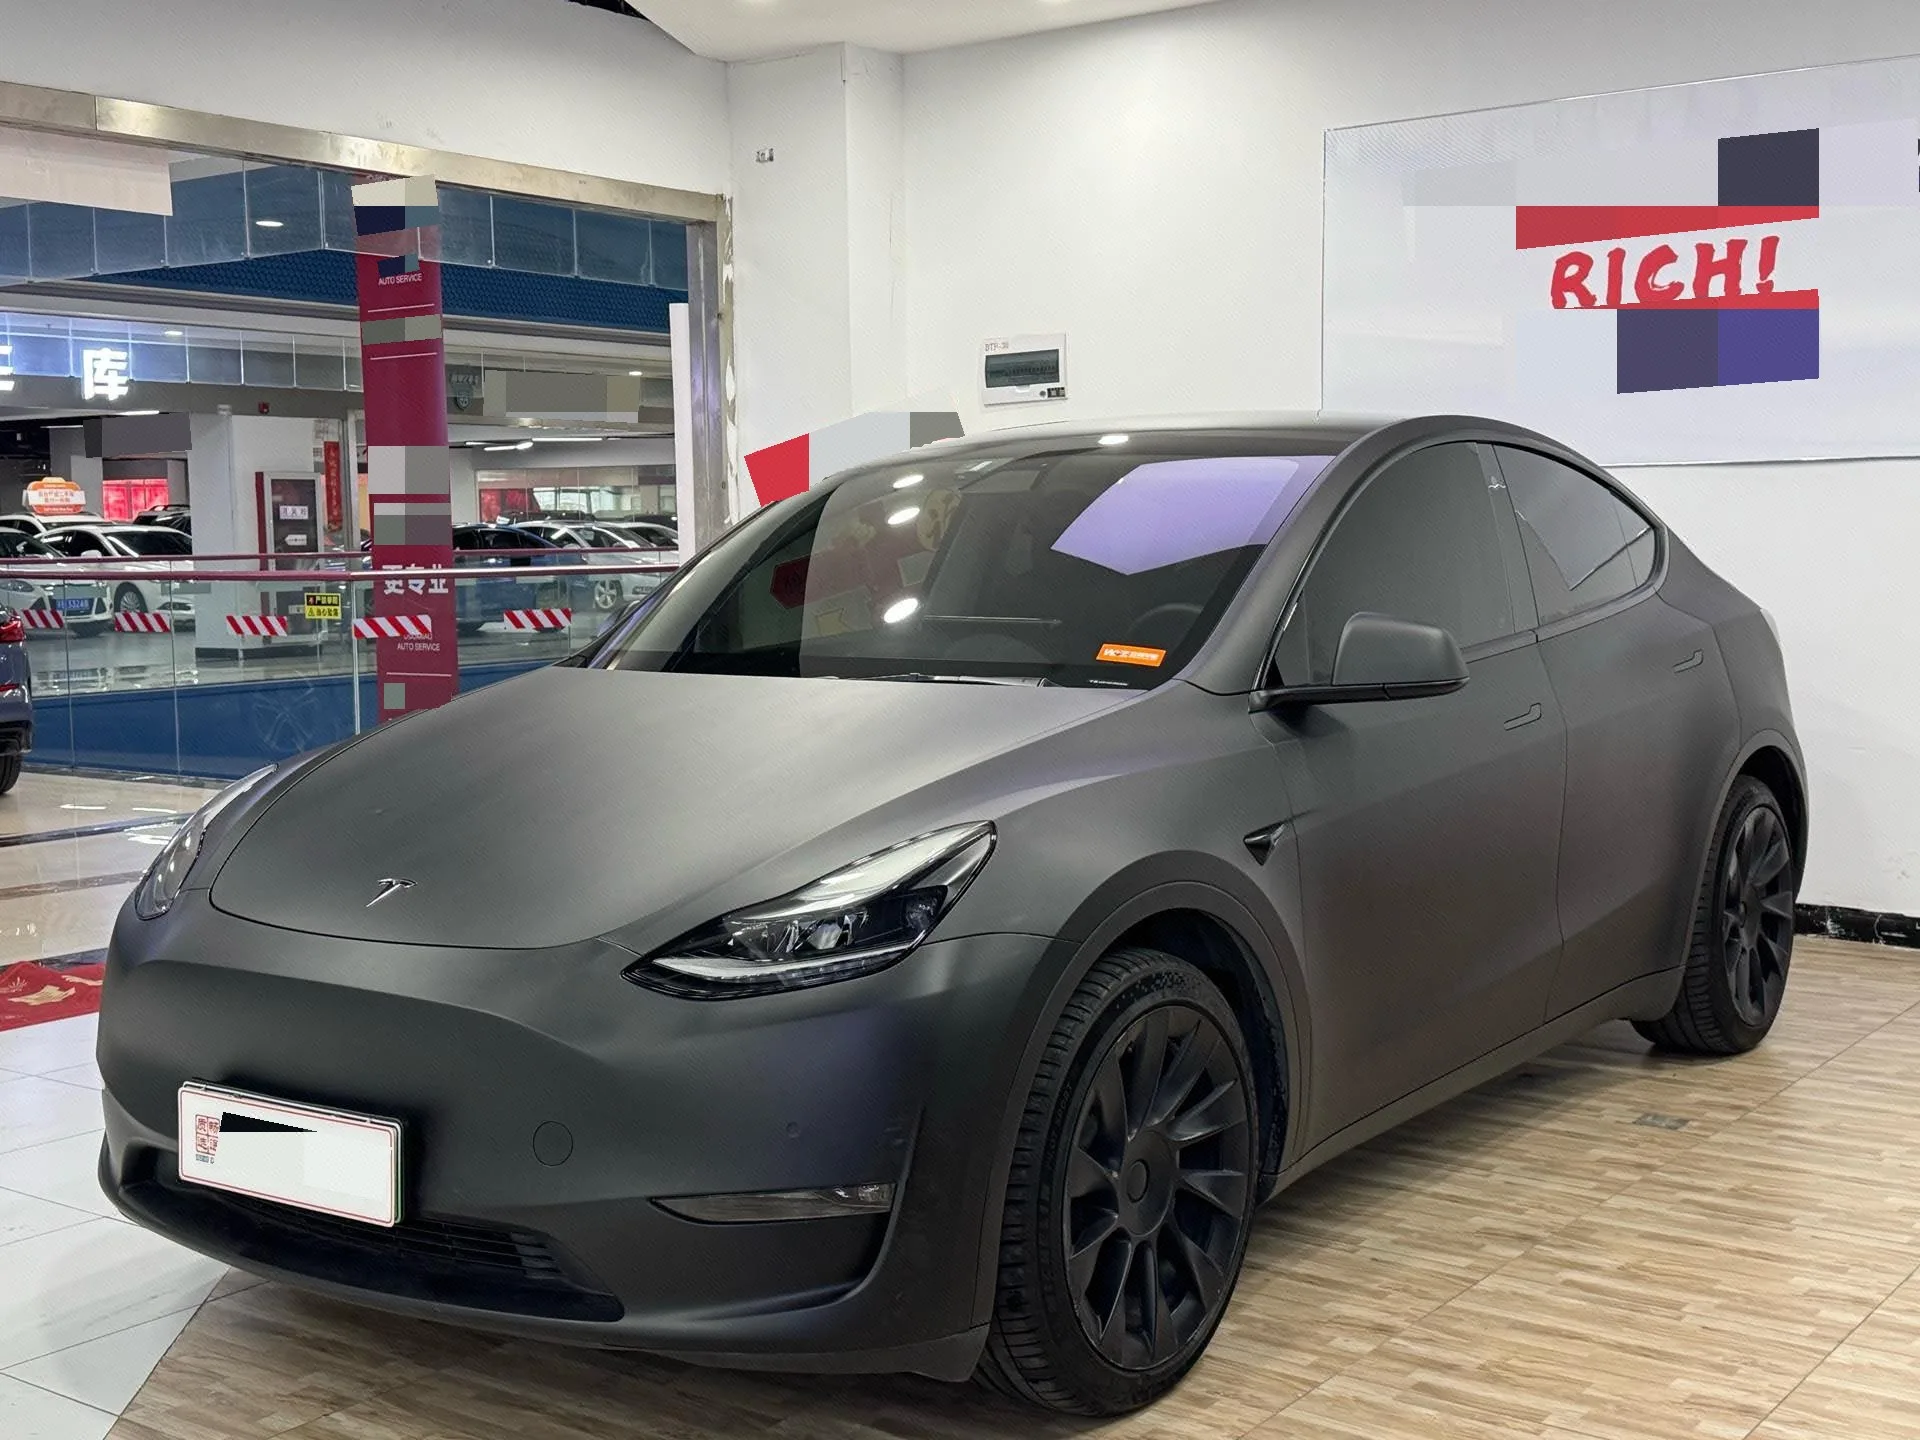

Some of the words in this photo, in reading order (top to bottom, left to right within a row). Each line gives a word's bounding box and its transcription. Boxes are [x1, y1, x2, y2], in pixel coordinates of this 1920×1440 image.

[1550, 235, 1780, 308] RICH!
[378, 276, 395, 286] AUTO
[395, 273, 422, 284] SERVICE
[397, 642, 414, 651] AUTO
[414, 642, 441, 652] SERVICE
